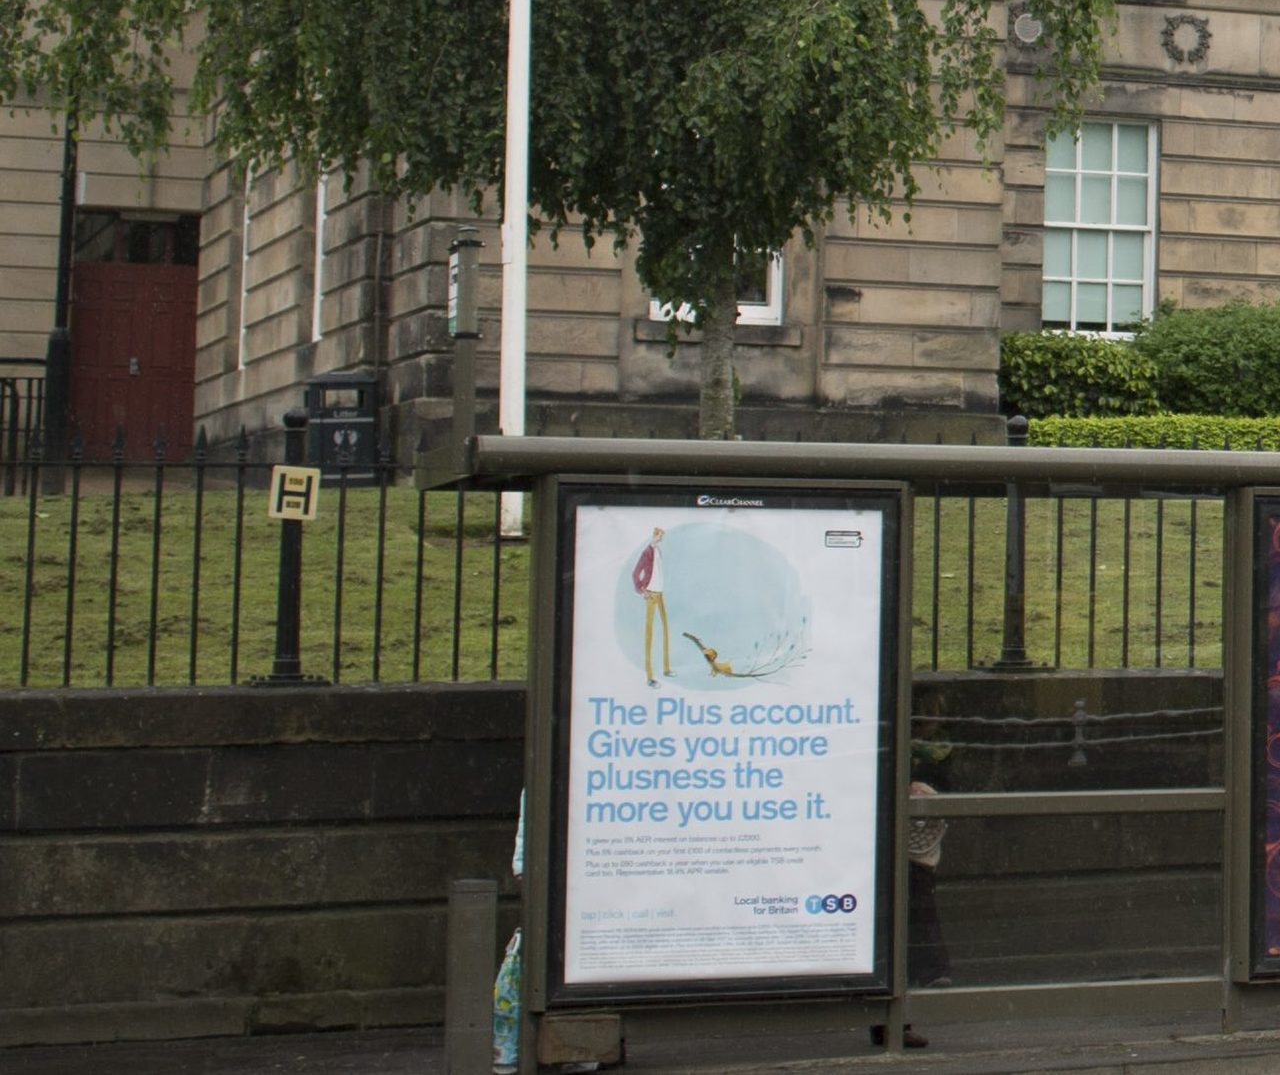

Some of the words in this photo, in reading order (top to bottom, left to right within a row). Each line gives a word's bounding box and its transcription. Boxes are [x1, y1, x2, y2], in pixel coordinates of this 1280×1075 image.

[588, 697, 647, 725] The
[656, 697, 722, 725] Plus
[730, 698, 860, 725] account.
[587, 729, 676, 758] Gives
[684, 736, 739, 763] you
[749, 735, 828, 757] more
[586, 762, 726, 796] plusness
[733, 761, 783, 788] the
[586, 799, 668, 823] more
[677, 799, 732, 828] you
[742, 799, 797, 821] use
[806, 792, 831, 820] it.
[735, 895, 759, 905] Local
[761, 895, 798, 906] banking
[753, 906, 766, 915] for
[768, 905, 798, 915] Britain
[809, 896, 855, 911] TSB
